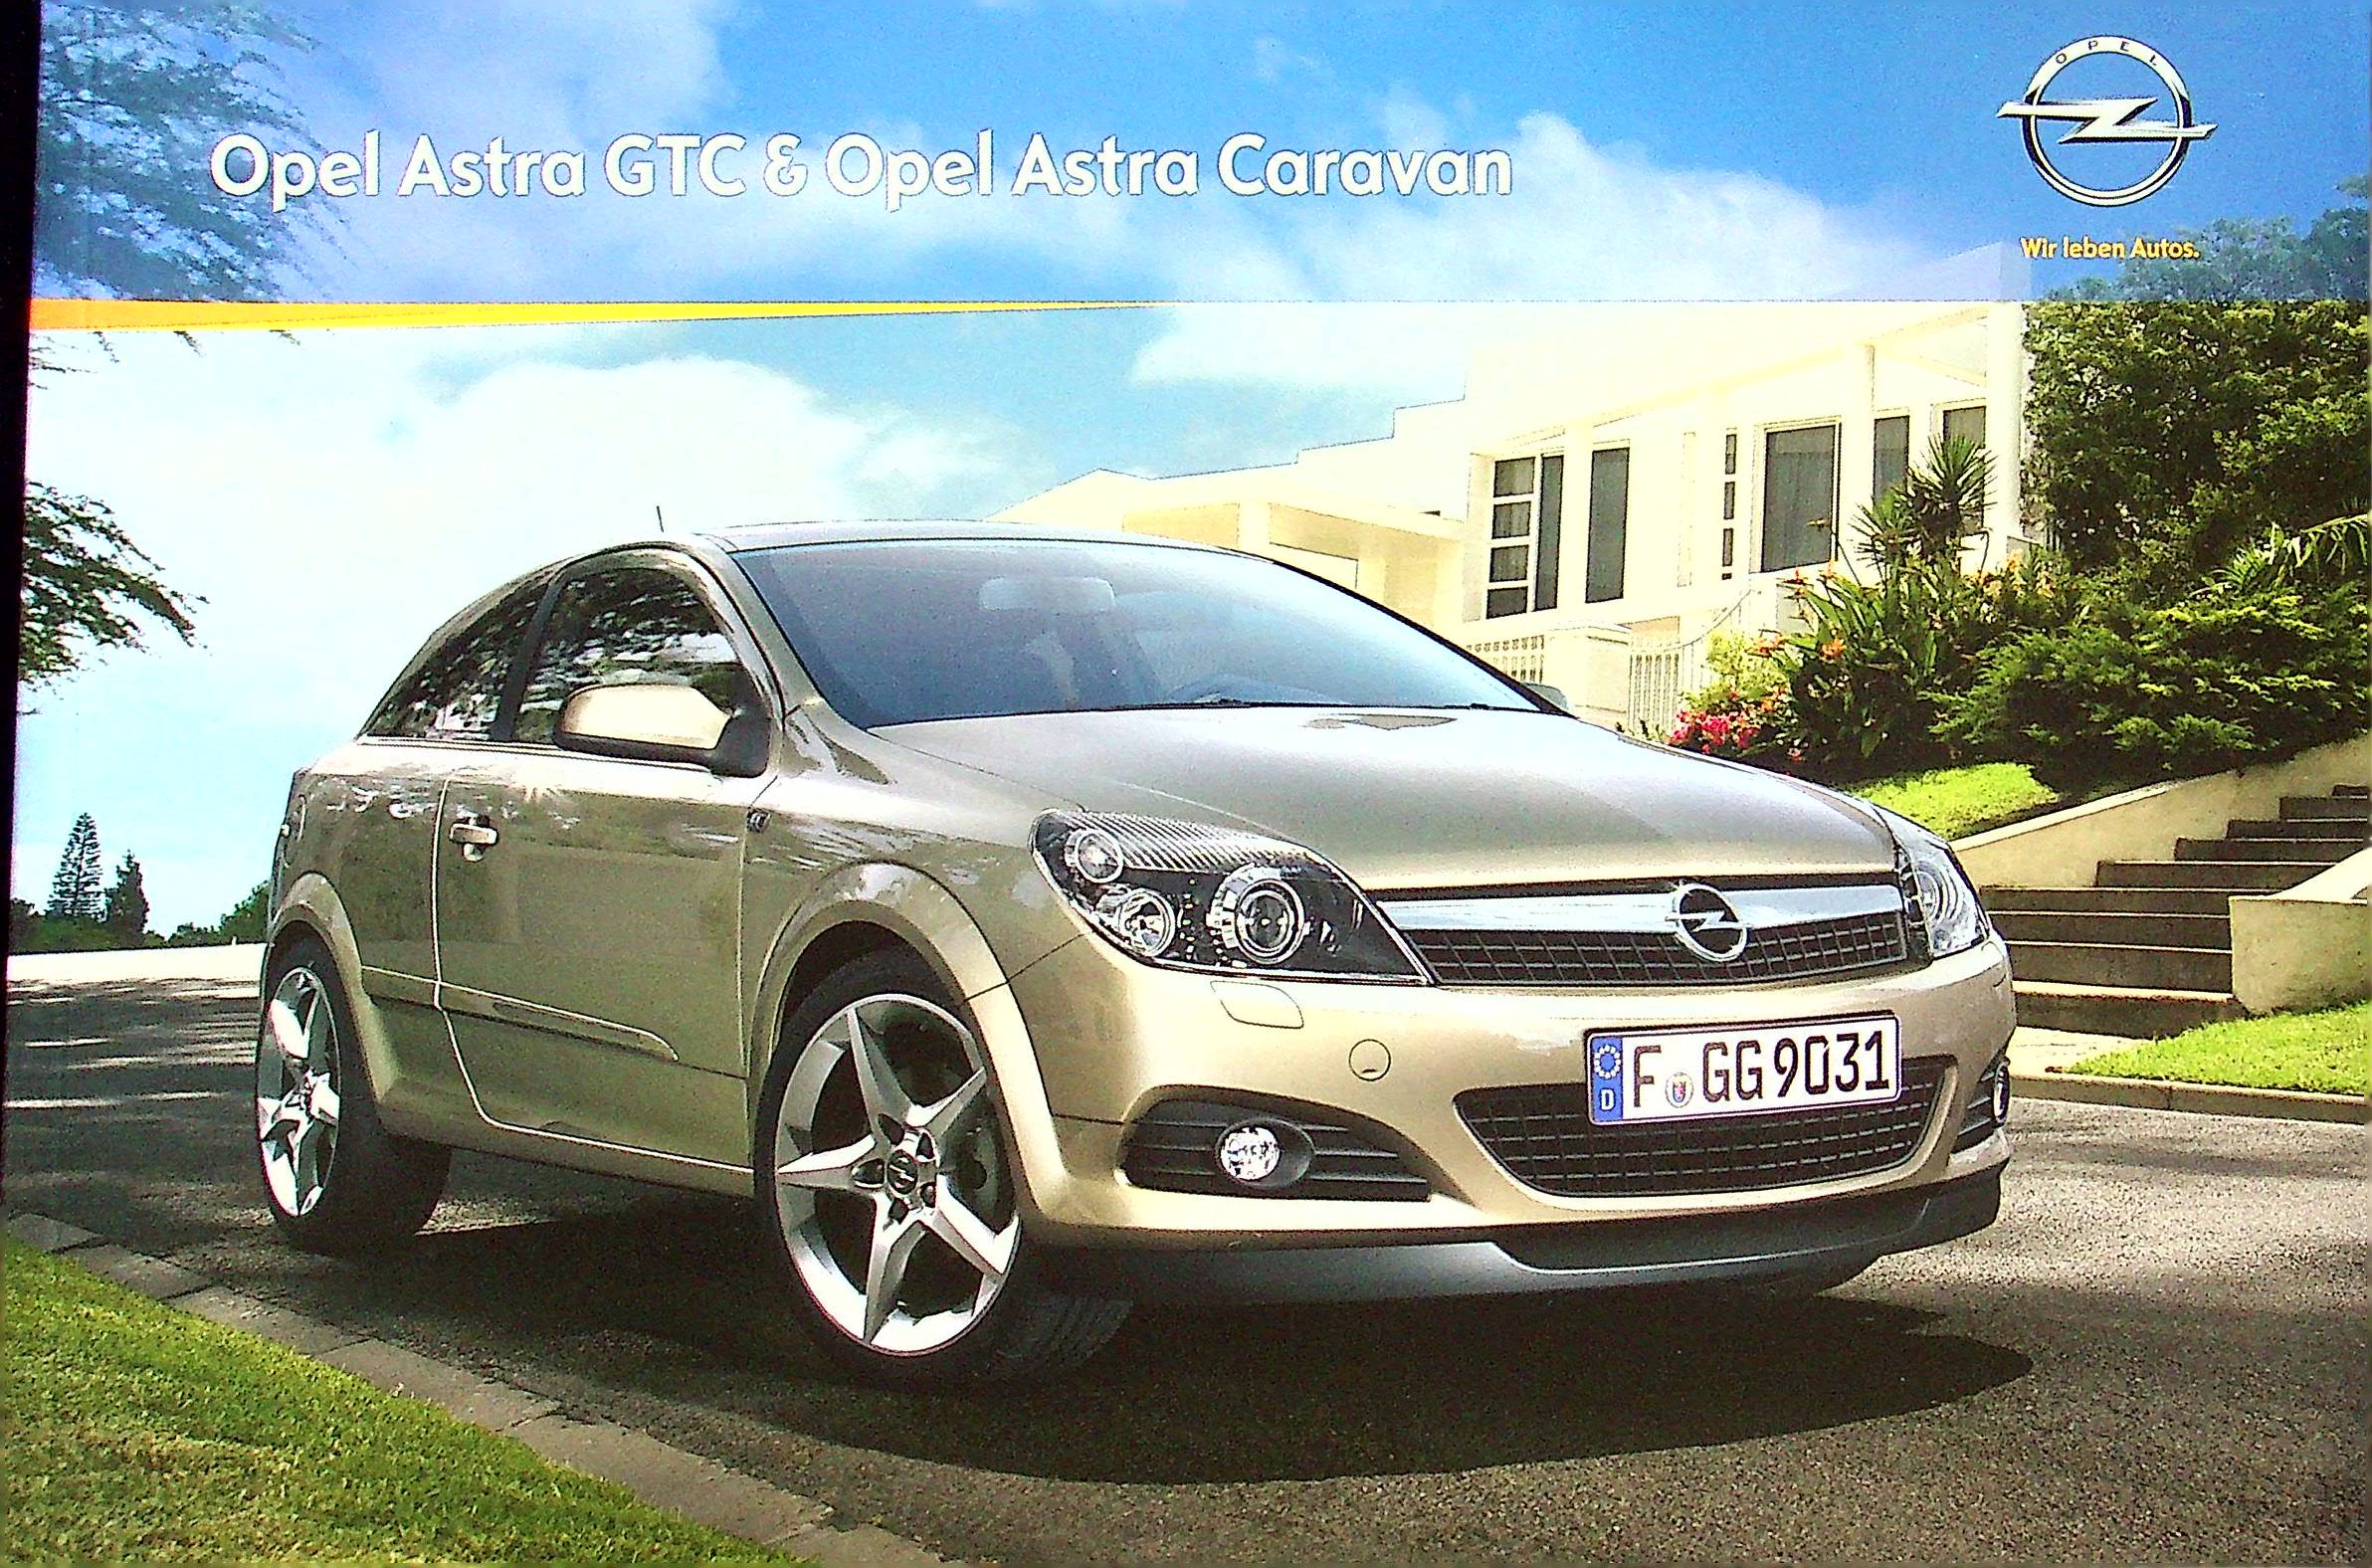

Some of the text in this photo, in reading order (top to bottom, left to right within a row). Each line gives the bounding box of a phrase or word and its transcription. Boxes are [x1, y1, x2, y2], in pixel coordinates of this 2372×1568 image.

[2055, 40, 2158, 67] OPEL
[209, 128, 1513, 215] Opel Astra GTC & Opel Astra Caravan
[2020, 236, 2200, 260] Wir leben Autos.
[1634, 1045, 1662, 1108] F
[1601, 1088, 1617, 1112] D
